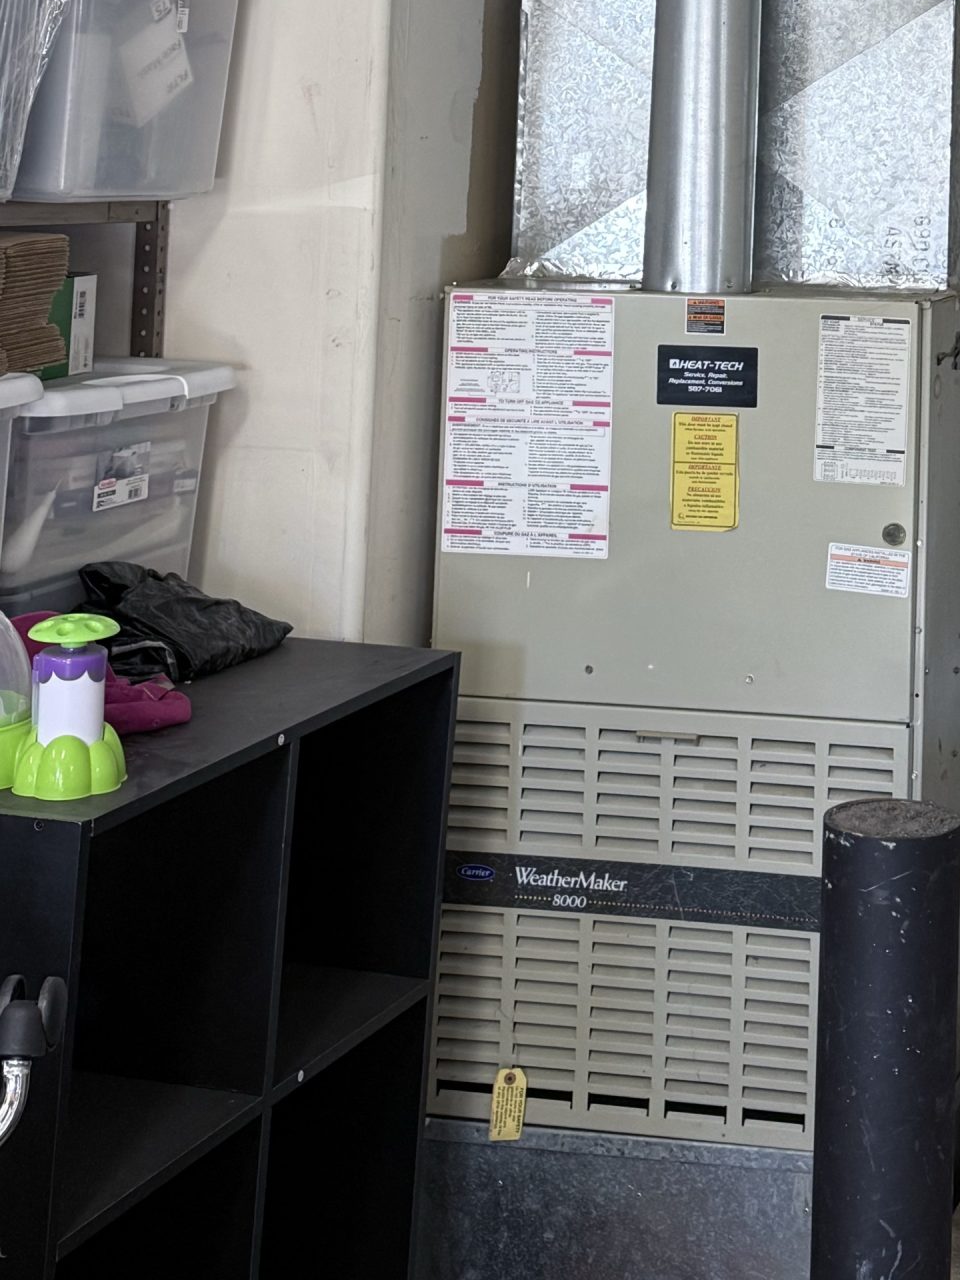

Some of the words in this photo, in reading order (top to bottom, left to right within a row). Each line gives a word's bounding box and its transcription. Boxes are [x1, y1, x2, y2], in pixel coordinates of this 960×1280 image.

[680, 360, 744, 371] HEAT-TECH
[668, 377, 706, 385] Replacement,
[461, 867, 491, 878] Carrier
[515, 866, 628, 891] WeatherMaker
[552, 894, 587, 908] 8000
